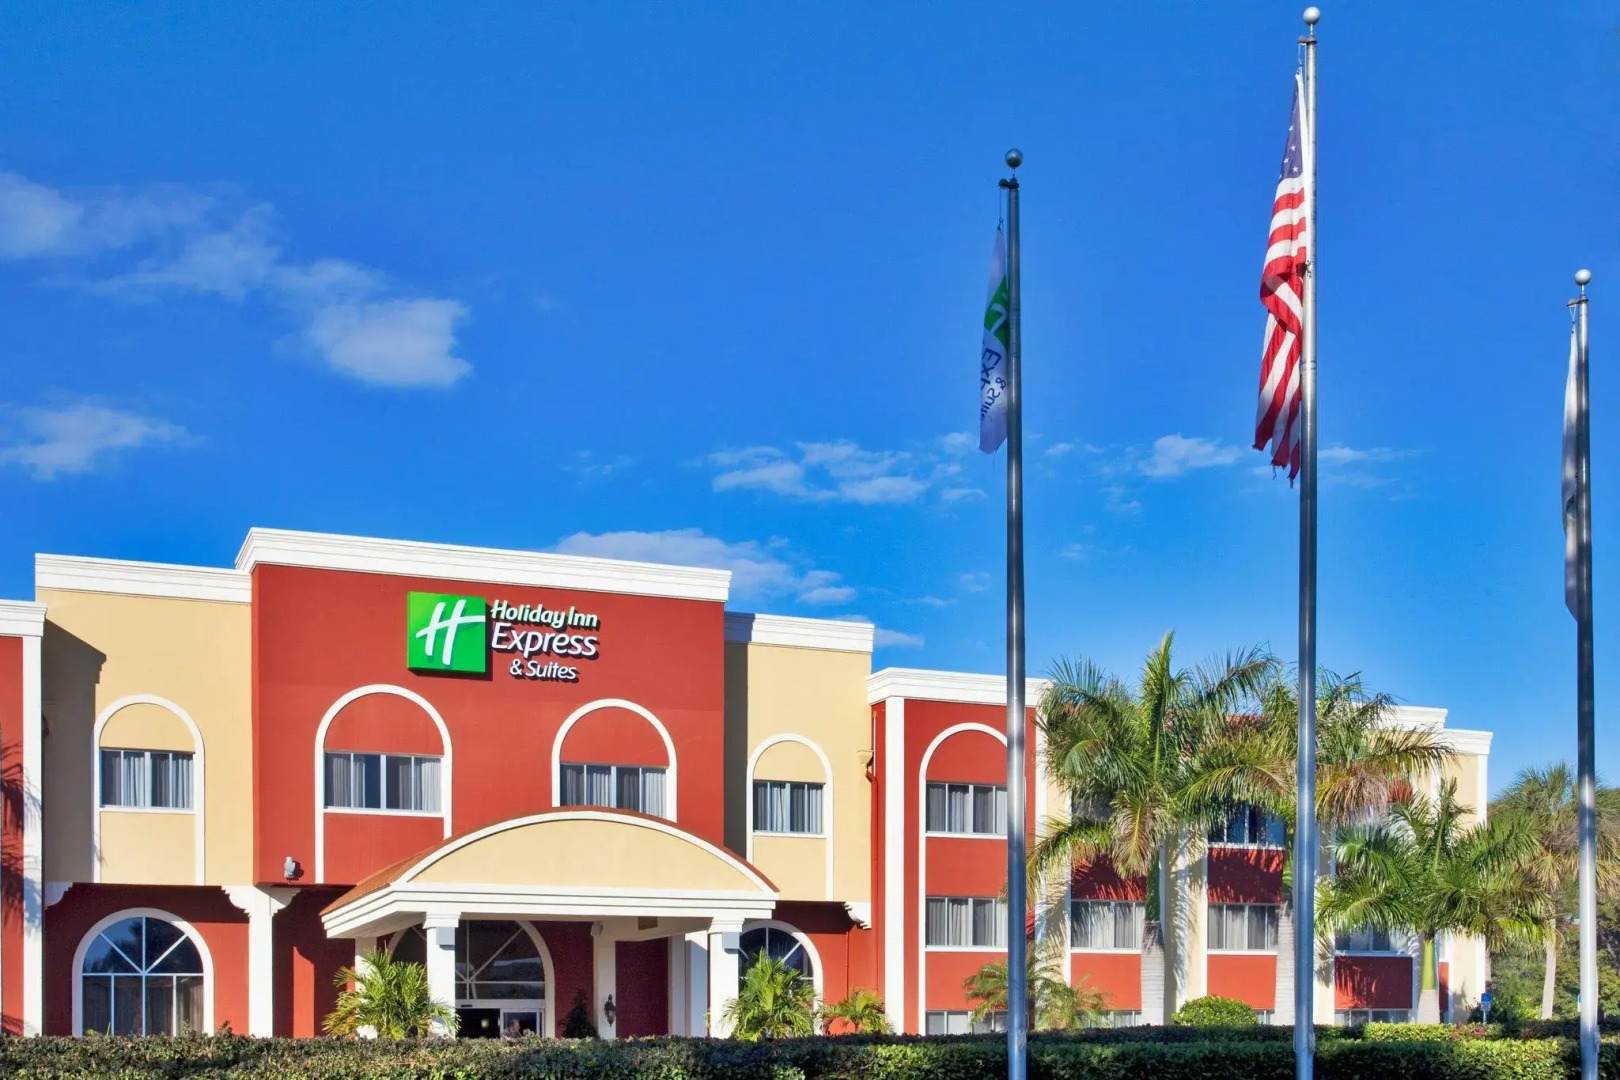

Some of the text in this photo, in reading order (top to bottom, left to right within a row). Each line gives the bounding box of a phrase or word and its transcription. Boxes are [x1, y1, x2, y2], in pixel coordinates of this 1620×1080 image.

[490, 599, 598, 628] Holiday Inn
[491, 622, 598, 659] Express
[509, 658, 577, 680] & Suites
